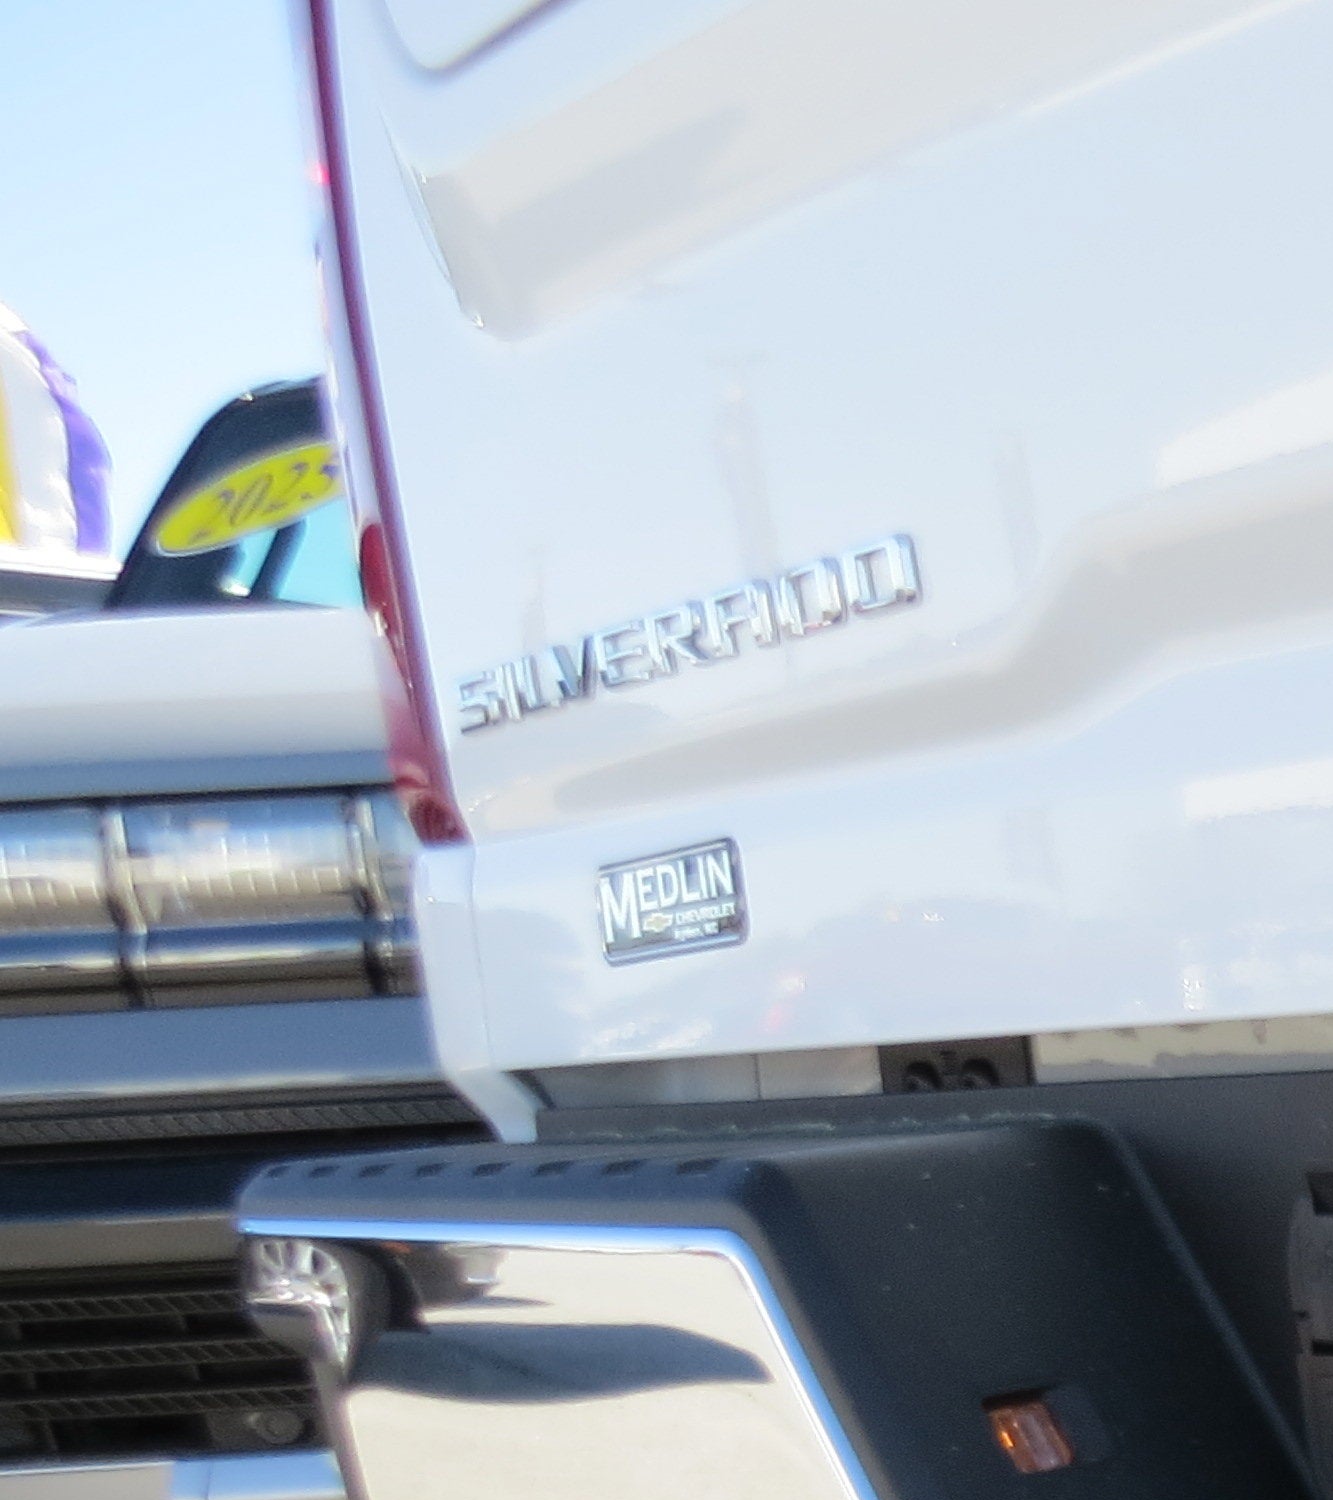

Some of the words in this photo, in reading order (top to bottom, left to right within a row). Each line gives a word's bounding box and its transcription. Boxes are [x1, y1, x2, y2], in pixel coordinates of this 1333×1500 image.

[456, 533, 922, 735] SILVERADO
[600, 849, 733, 943] MEDLIN
[675, 902, 735, 925] CHEVROLET
